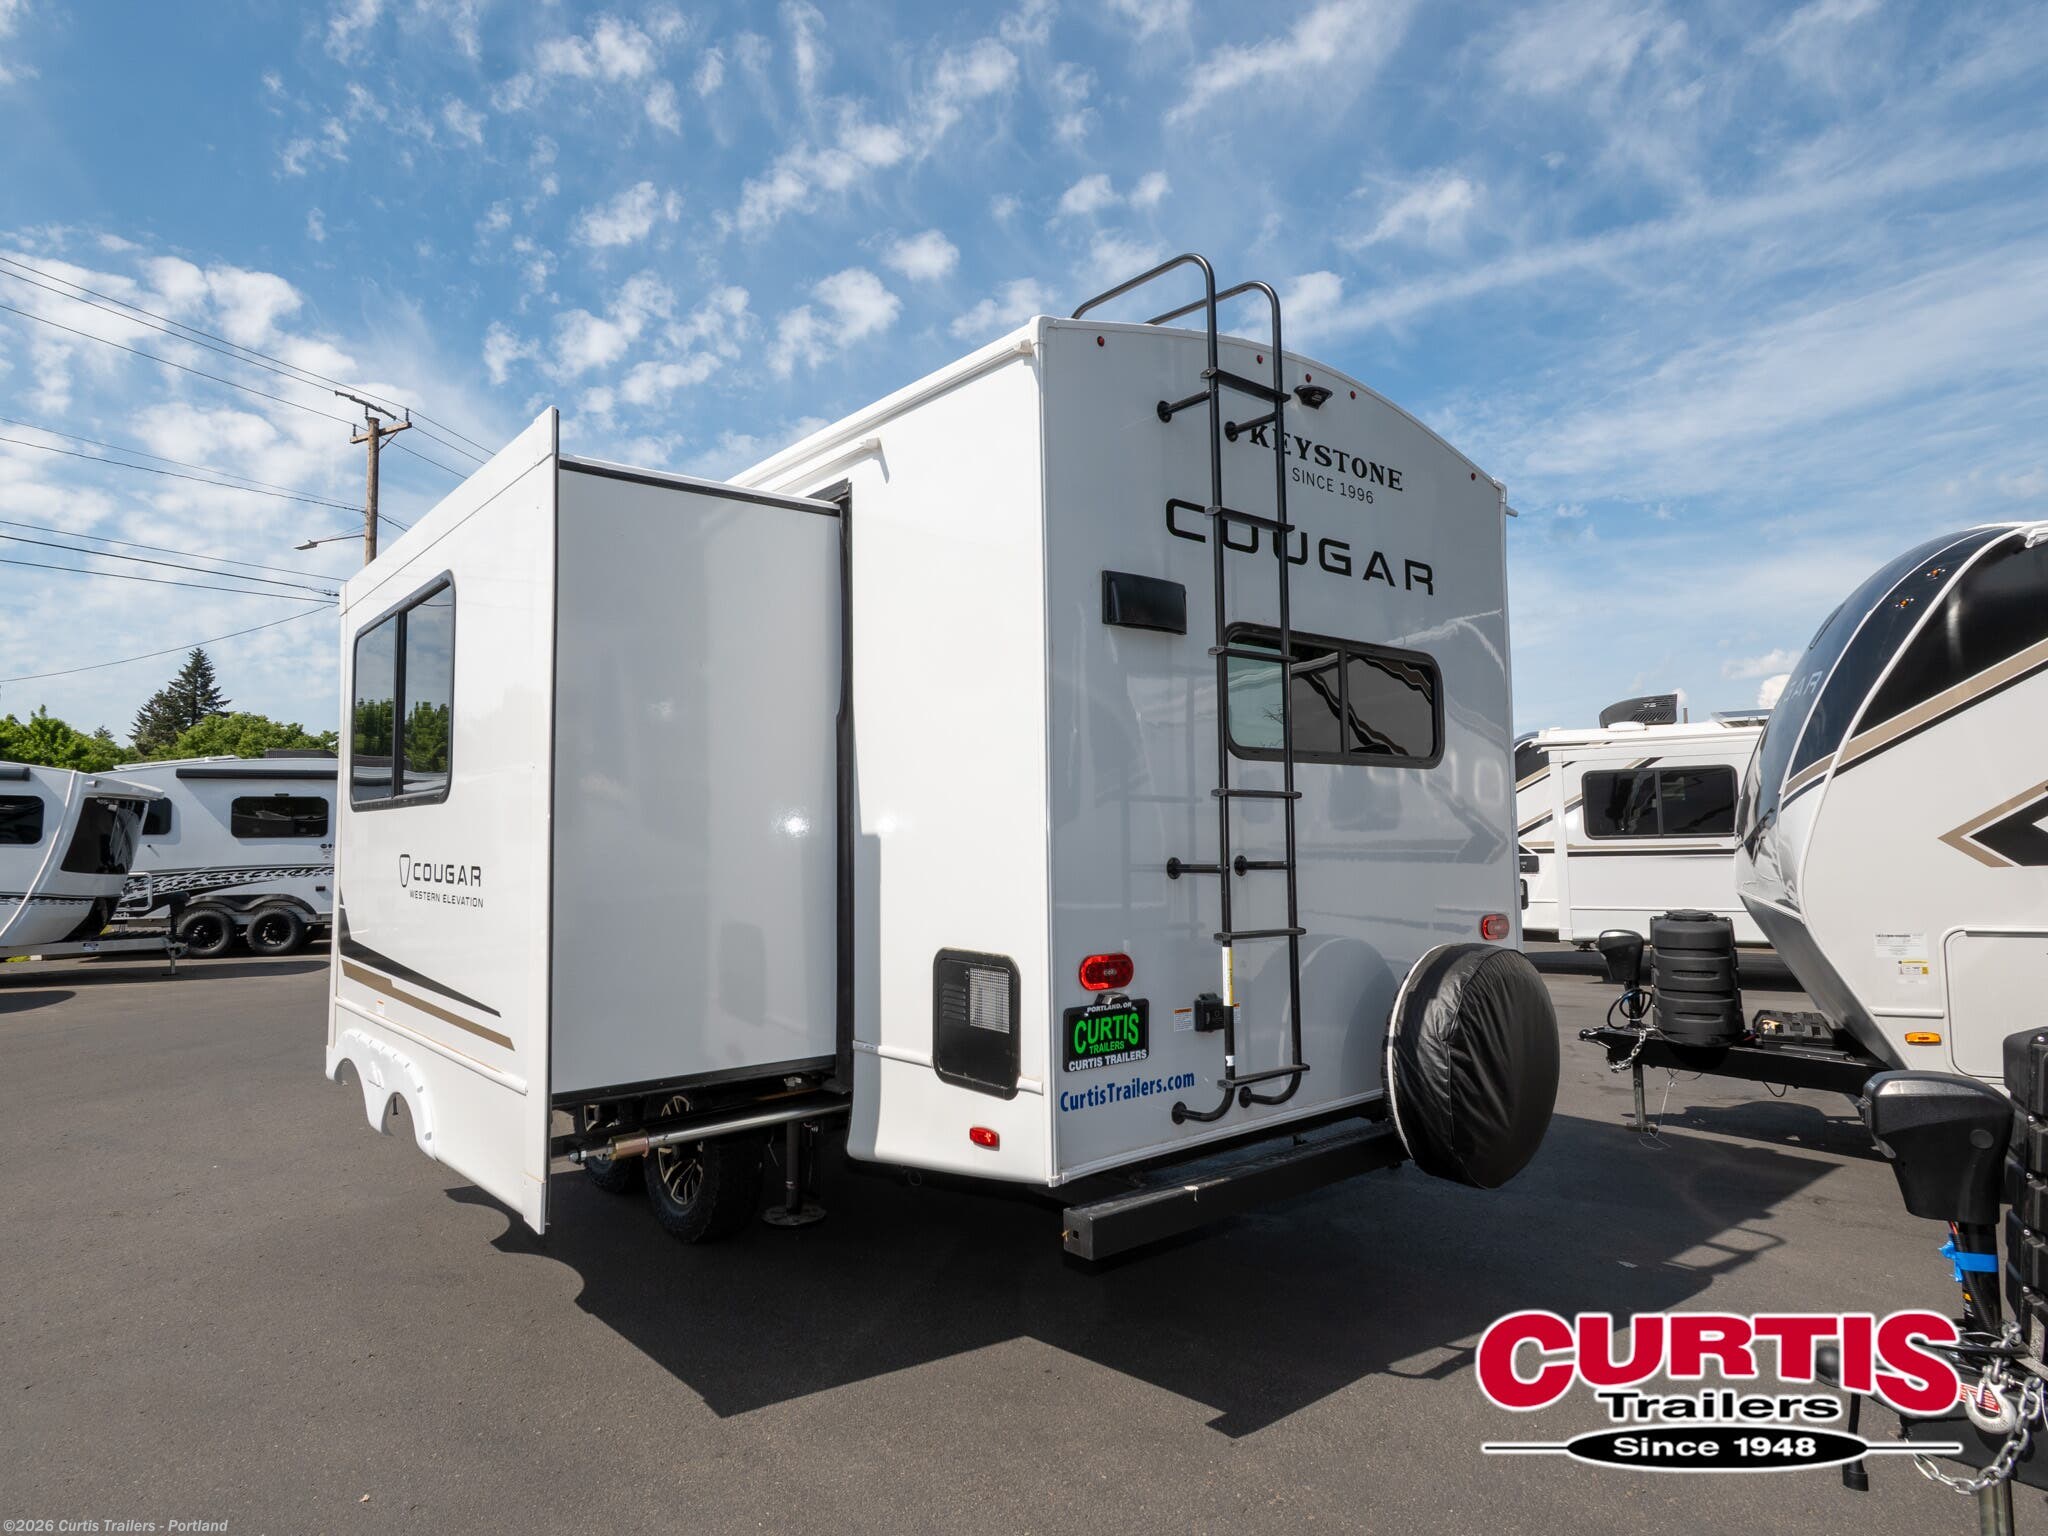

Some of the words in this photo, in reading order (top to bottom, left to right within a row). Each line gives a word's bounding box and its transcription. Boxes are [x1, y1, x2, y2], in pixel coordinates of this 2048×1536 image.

[1250, 424, 1403, 491] KEYSTONE
[1292, 467, 1334, 493] SINCE
[1340, 482, 1374, 504] 1996
[1166, 498, 1434, 595] COUGAR
[413, 862, 481, 887] COUGAR
[409, 889, 440, 903] WESTERN
[443, 893, 484, 908] ELEVATION
[1074, 1012, 1139, 1054] CURTIS
[1089, 1041, 1125, 1055] TRAILERS
[1068, 1056, 1103, 1071] CURTIS
[1104, 1049, 1147, 1066] TRAILERS
[1060, 1071, 1195, 1112] CurtisTrailers.com
